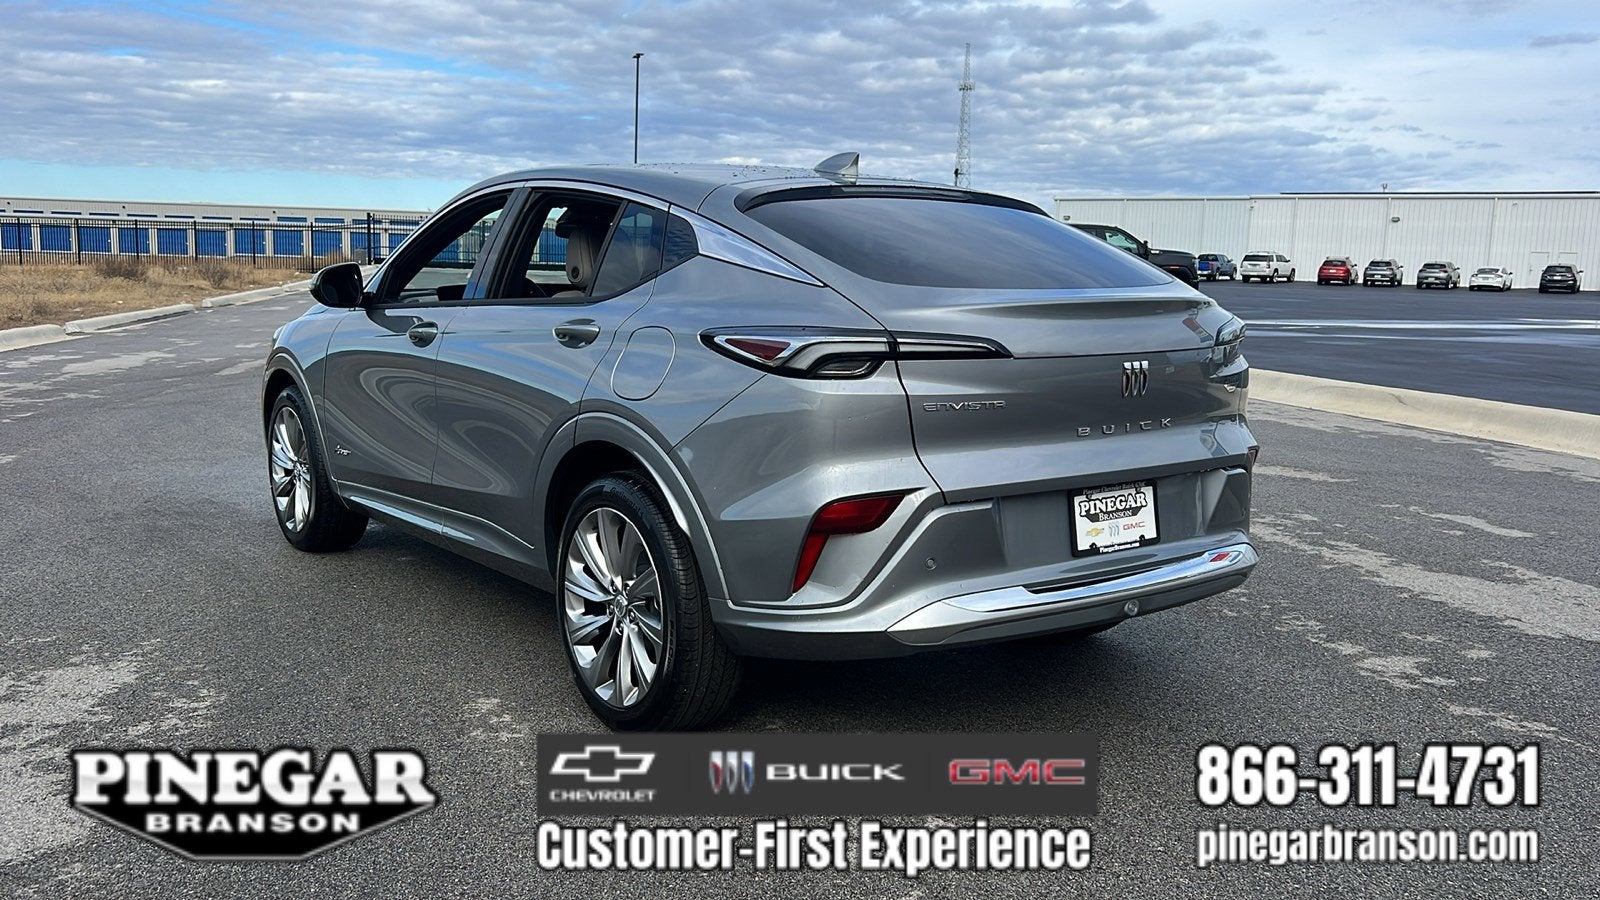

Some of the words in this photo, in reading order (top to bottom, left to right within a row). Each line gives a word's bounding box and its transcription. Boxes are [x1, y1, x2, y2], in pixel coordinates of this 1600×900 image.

[923, 400, 1007, 412] ENVISTA
[1076, 417, 1172, 438] BUICK
[1080, 493, 1147, 516] PINEGAR
[1098, 509, 1133, 521] BRANSON
[1123, 521, 1145, 531] GMC
